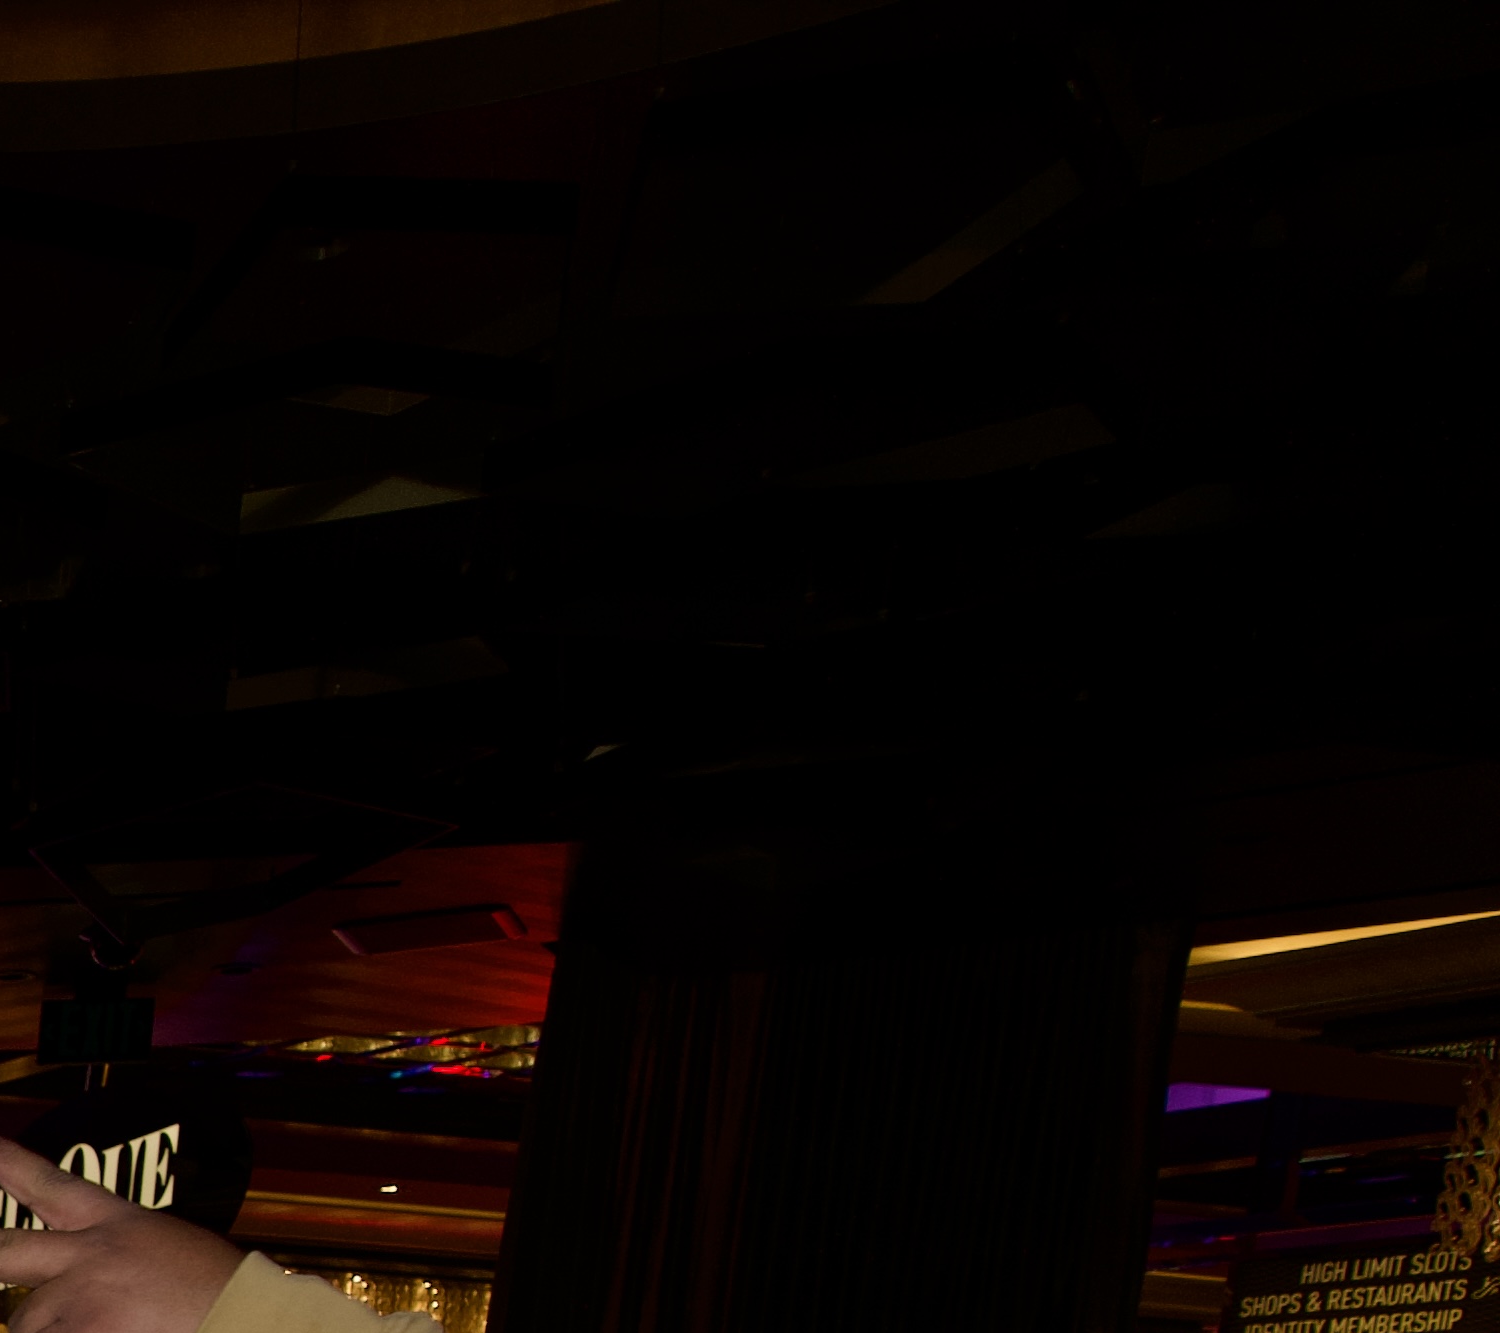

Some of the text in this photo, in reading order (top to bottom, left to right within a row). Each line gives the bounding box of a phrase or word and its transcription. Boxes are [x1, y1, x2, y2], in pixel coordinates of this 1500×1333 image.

[58, 1001, 138, 1056] EXIT
[1302, 1251, 1472, 1284] HIGH LIMIT SLOTS
[1240, 1279, 1468, 1318] SHOPS & RESTAURANTS
